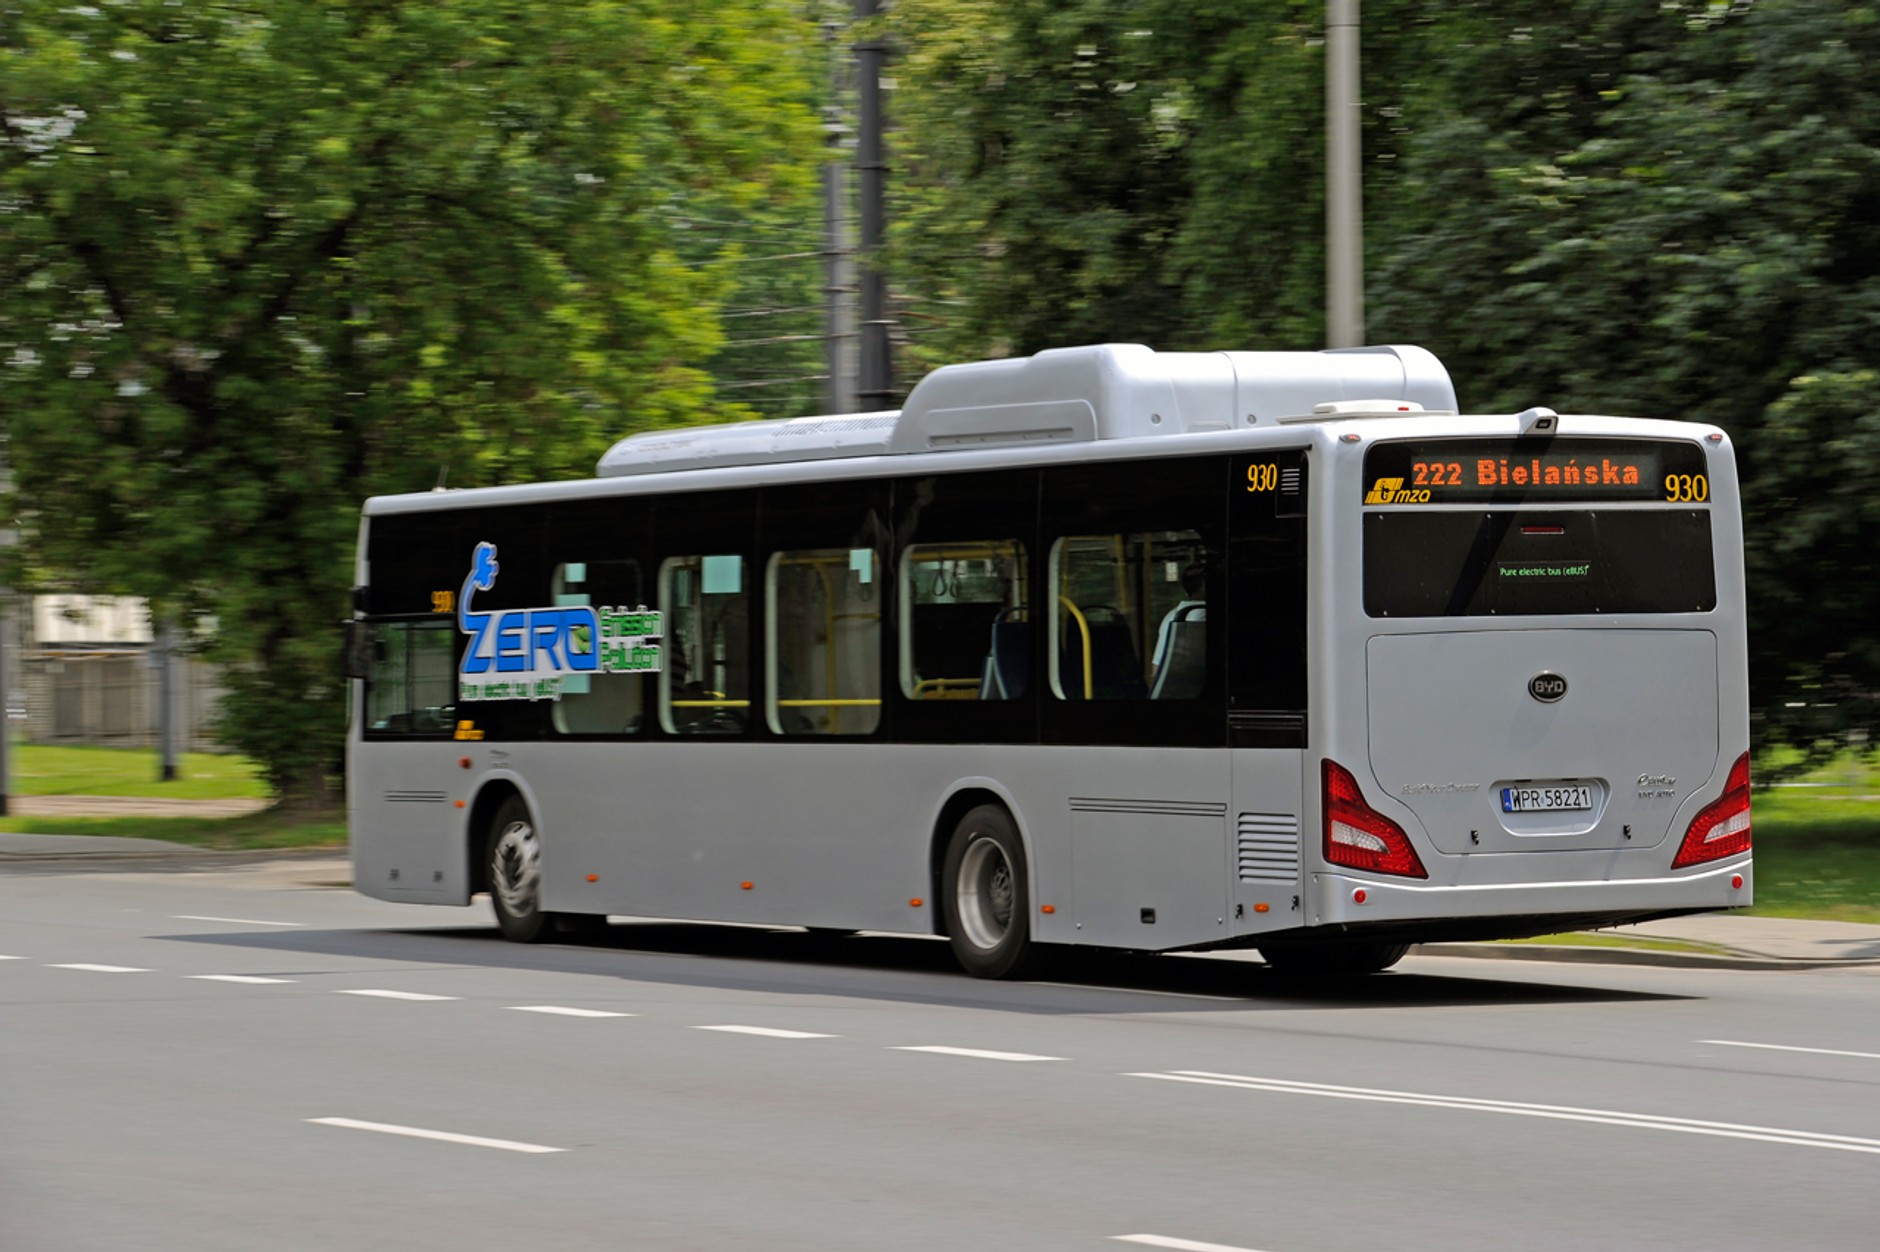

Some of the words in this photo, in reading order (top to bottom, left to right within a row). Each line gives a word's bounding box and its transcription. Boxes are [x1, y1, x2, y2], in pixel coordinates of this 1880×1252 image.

[1247, 463, 1278, 492] 930
[1413, 462, 1463, 486] 222
[1477, 459, 1640, 486] Bielańska
[1394, 489, 1431, 503] mza
[1664, 474, 1708, 503] 930
[1500, 567, 1517, 576] Pure
[1519, 567, 1546, 576] electric
[1547, 567, 1562, 576] bus
[462, 608, 598, 674] ZERO
[1535, 680, 1564, 692] BYD
[1545, 788, 1589, 807] 58221
